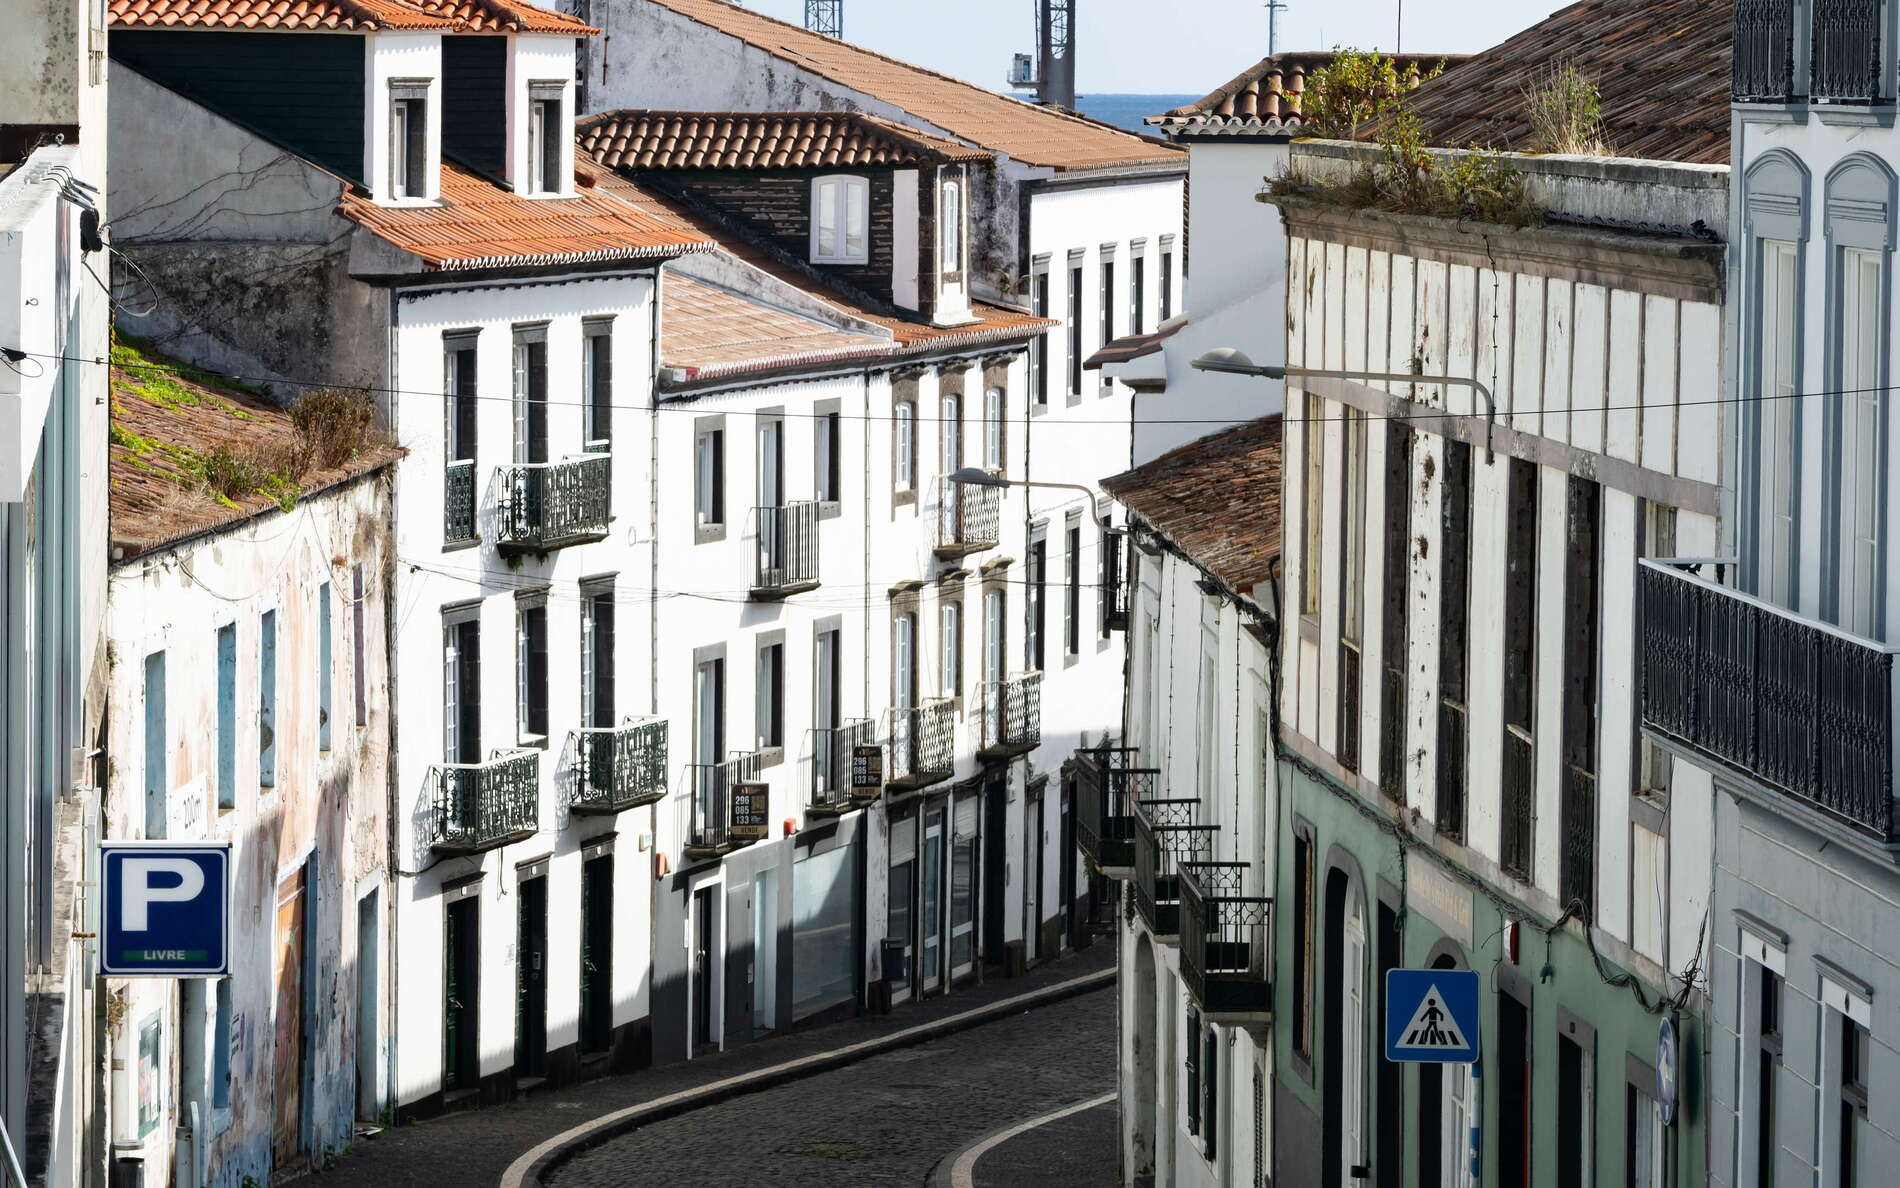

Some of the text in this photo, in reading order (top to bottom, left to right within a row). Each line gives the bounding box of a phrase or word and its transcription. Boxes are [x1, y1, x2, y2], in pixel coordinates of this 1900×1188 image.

[854, 757, 867, 765] 296
[854, 776, 867, 784] 133
[735, 796, 750, 805] 296
[735, 805, 750, 815] 085
[735, 815, 750, 825] 133
[122, 858, 205, 931] P
[143, 950, 185, 960] LIVRE
